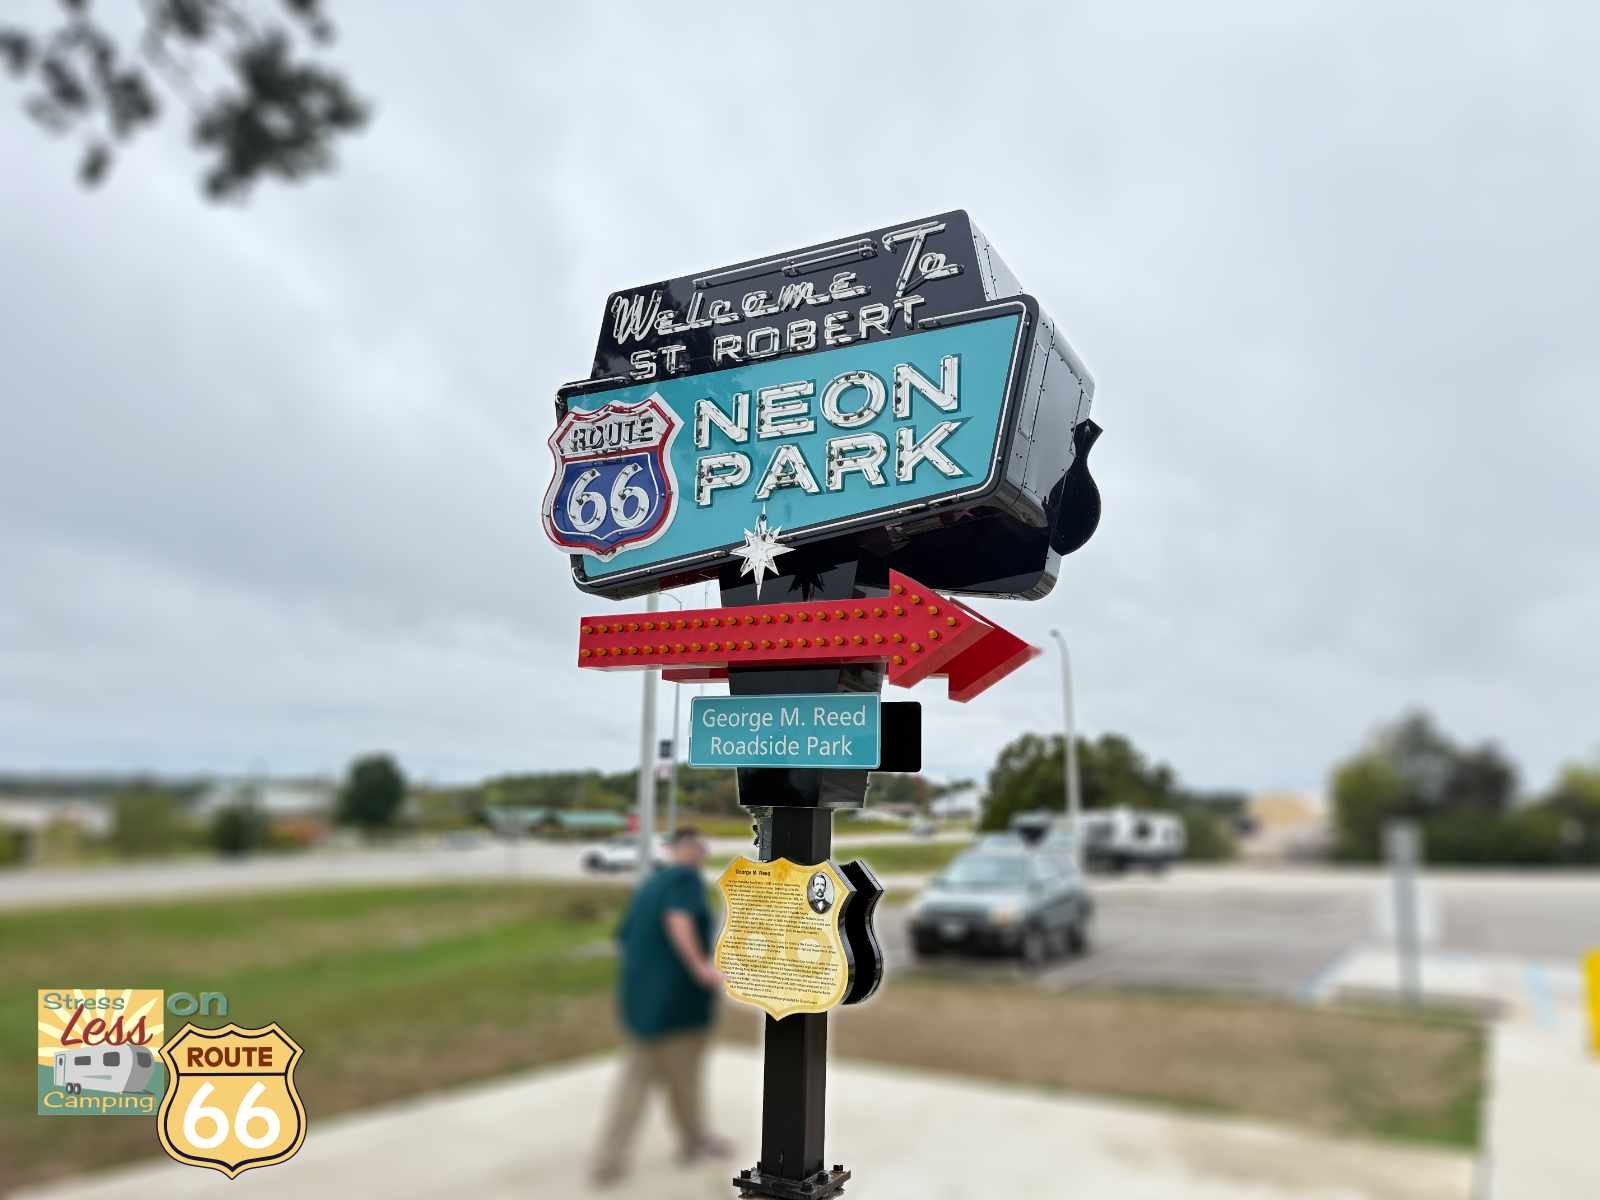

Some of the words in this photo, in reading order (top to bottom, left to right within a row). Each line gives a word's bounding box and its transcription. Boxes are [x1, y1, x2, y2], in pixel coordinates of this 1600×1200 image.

[611, 271, 871, 345] Welcome
[881, 221, 965, 297] To
[629, 344, 688, 381] ST
[713, 295, 927, 366] ROBERT
[568, 415, 655, 452] ROUTE
[694, 354, 961, 448] NEON
[567, 463, 647, 531] 66
[695, 421, 967, 507] PARK
[702, 708, 773, 732] George
[780, 707, 805, 727] M.
[813, 705, 866, 727] Reed
[711, 735, 800, 756] Roadside
[807, 736, 853, 756] Park
